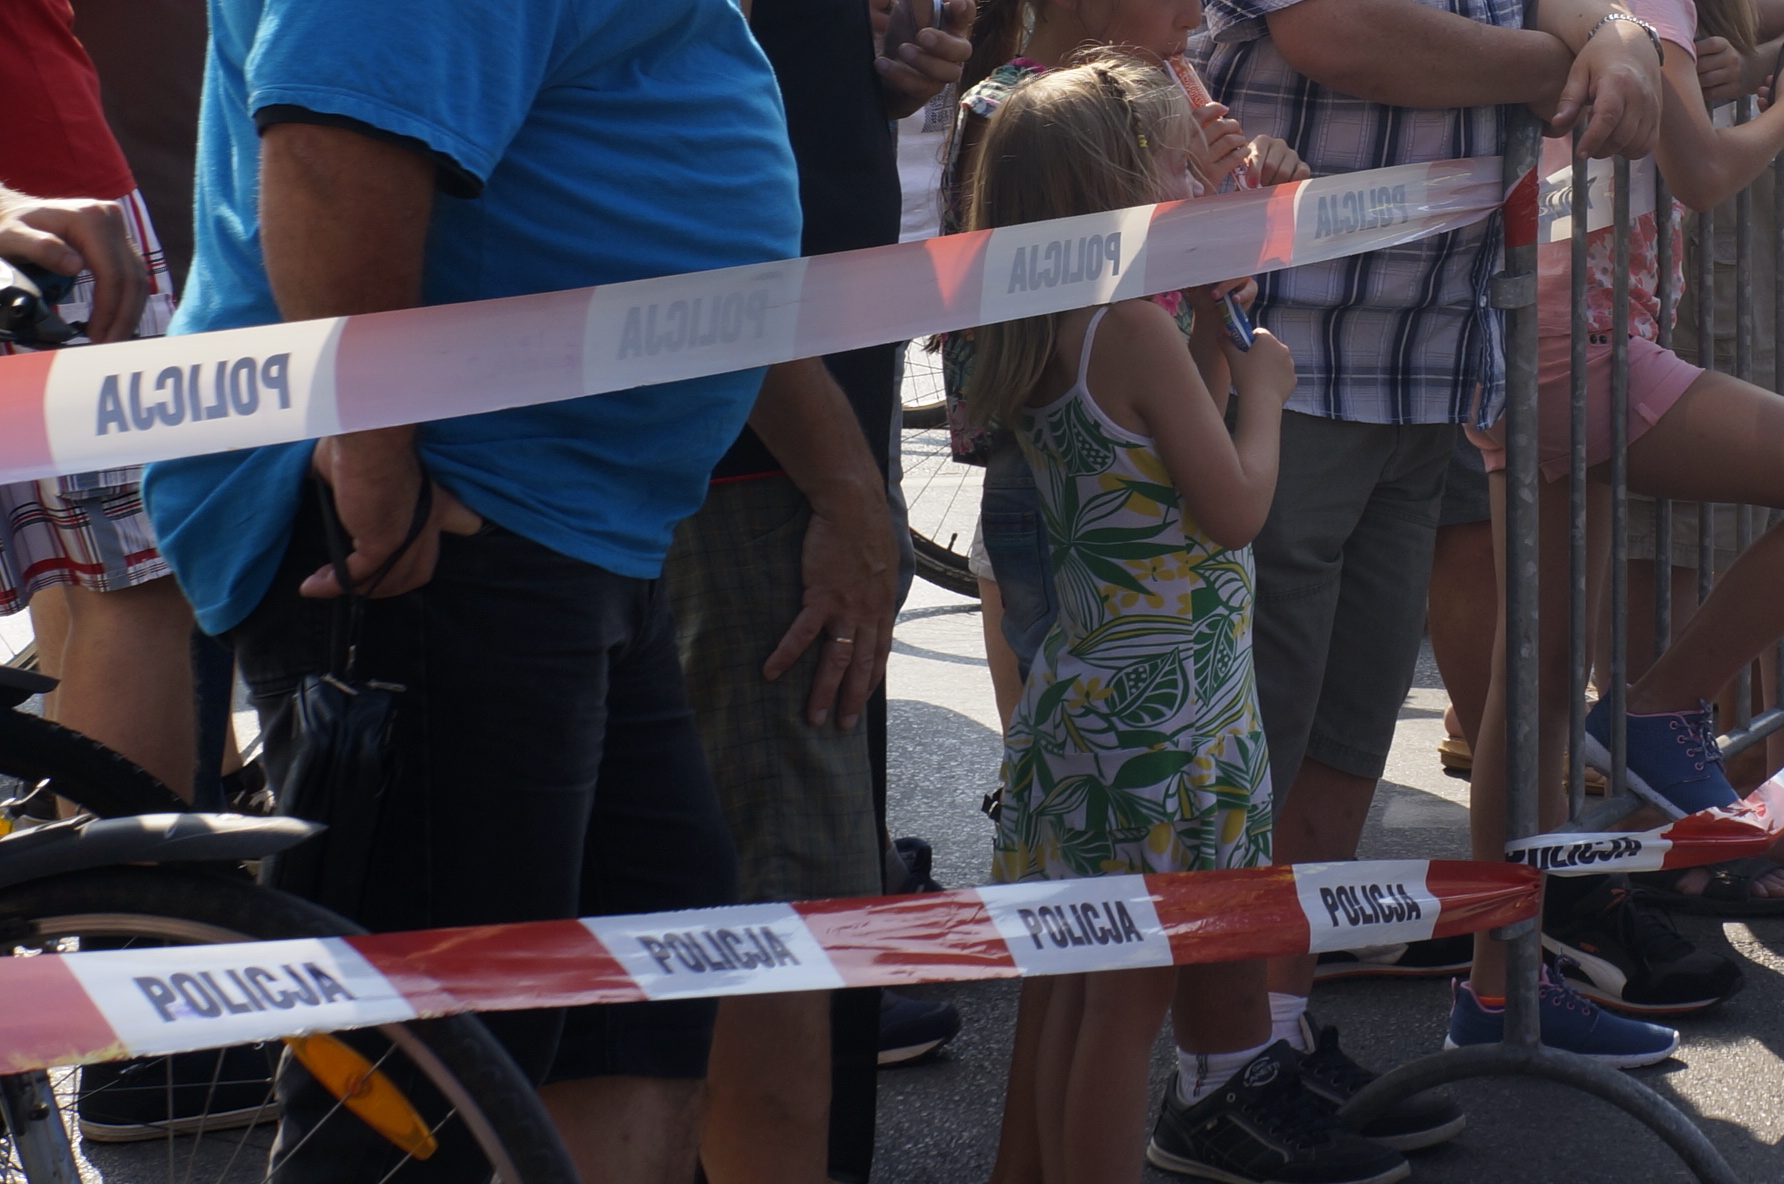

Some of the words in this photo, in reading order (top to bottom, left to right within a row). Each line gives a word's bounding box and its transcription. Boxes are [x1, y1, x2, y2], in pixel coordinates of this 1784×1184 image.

[1017, 899, 1144, 951] POLICJA
[1318, 882, 1422, 928] POLICJA
[636, 925, 802, 976] POLICJA
[132, 960, 356, 1024] POLICJA
